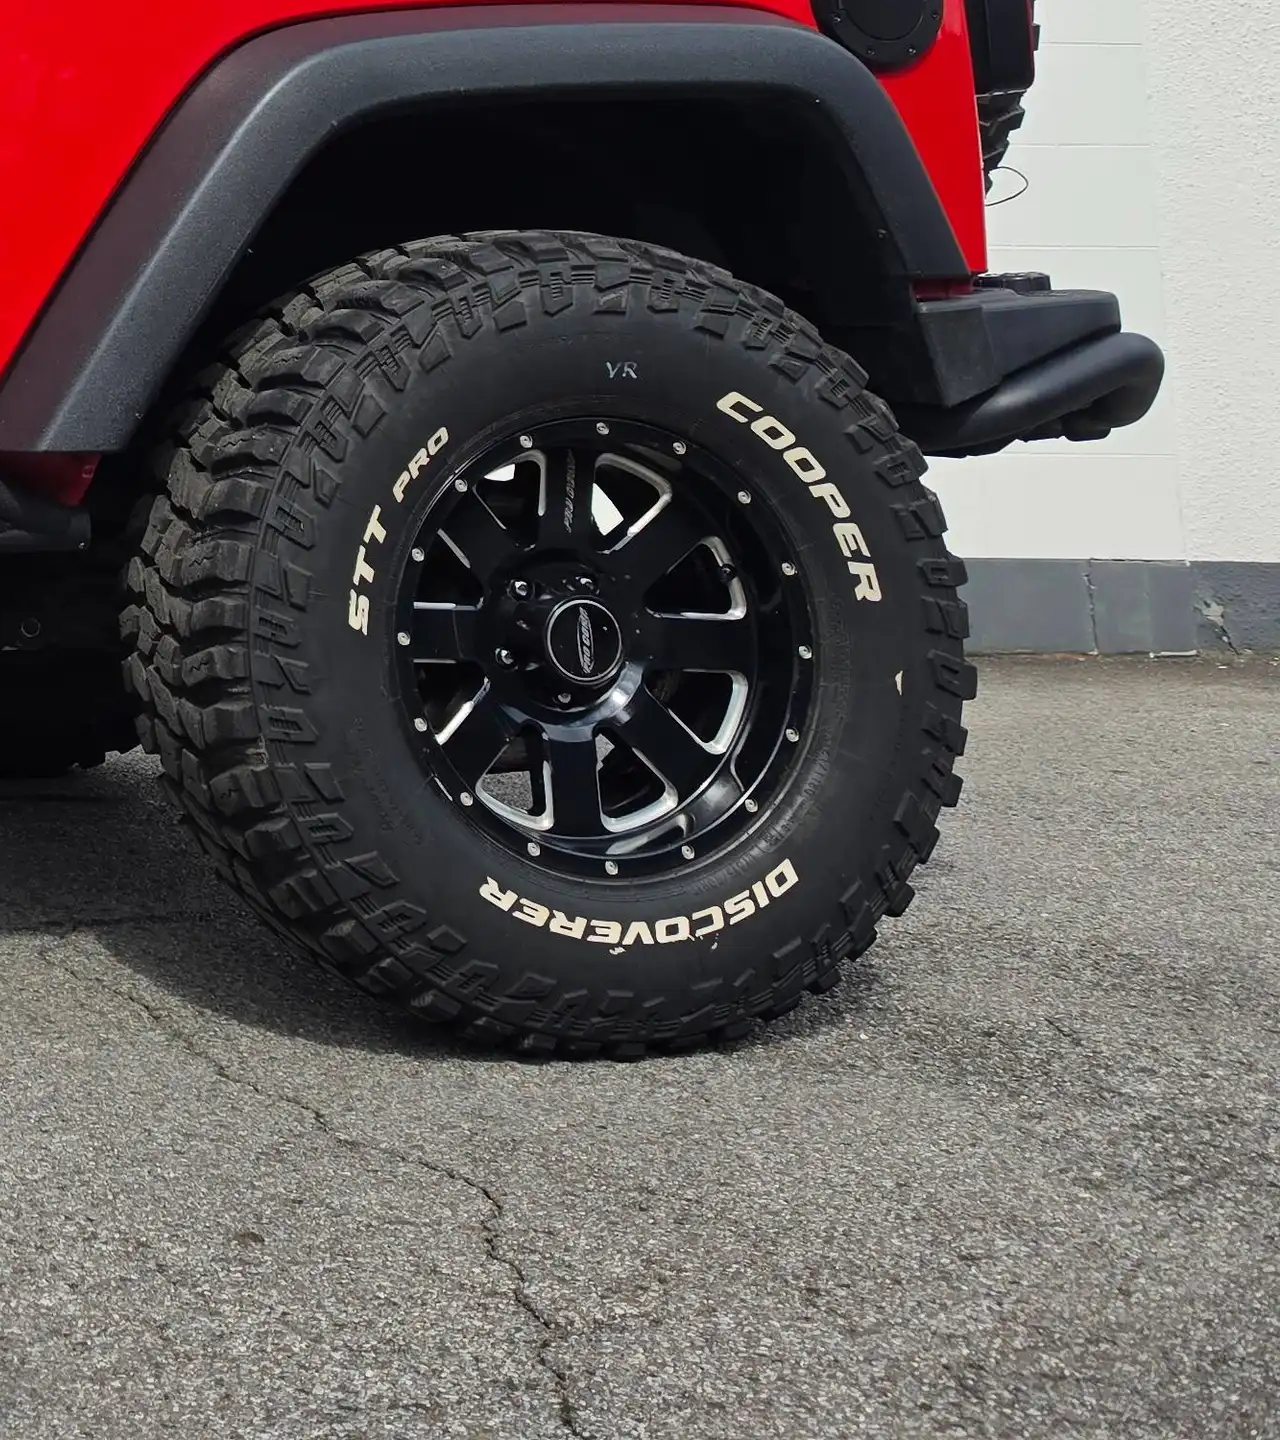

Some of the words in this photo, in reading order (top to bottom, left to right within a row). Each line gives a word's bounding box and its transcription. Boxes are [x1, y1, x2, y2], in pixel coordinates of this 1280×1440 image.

[605, 361, 638, 380] VR
[348, 504, 387, 636] STT
[392, 426, 449, 503] PRO
[716, 391, 882, 602] COOPER
[478, 858, 800, 945] DISCOVERER
